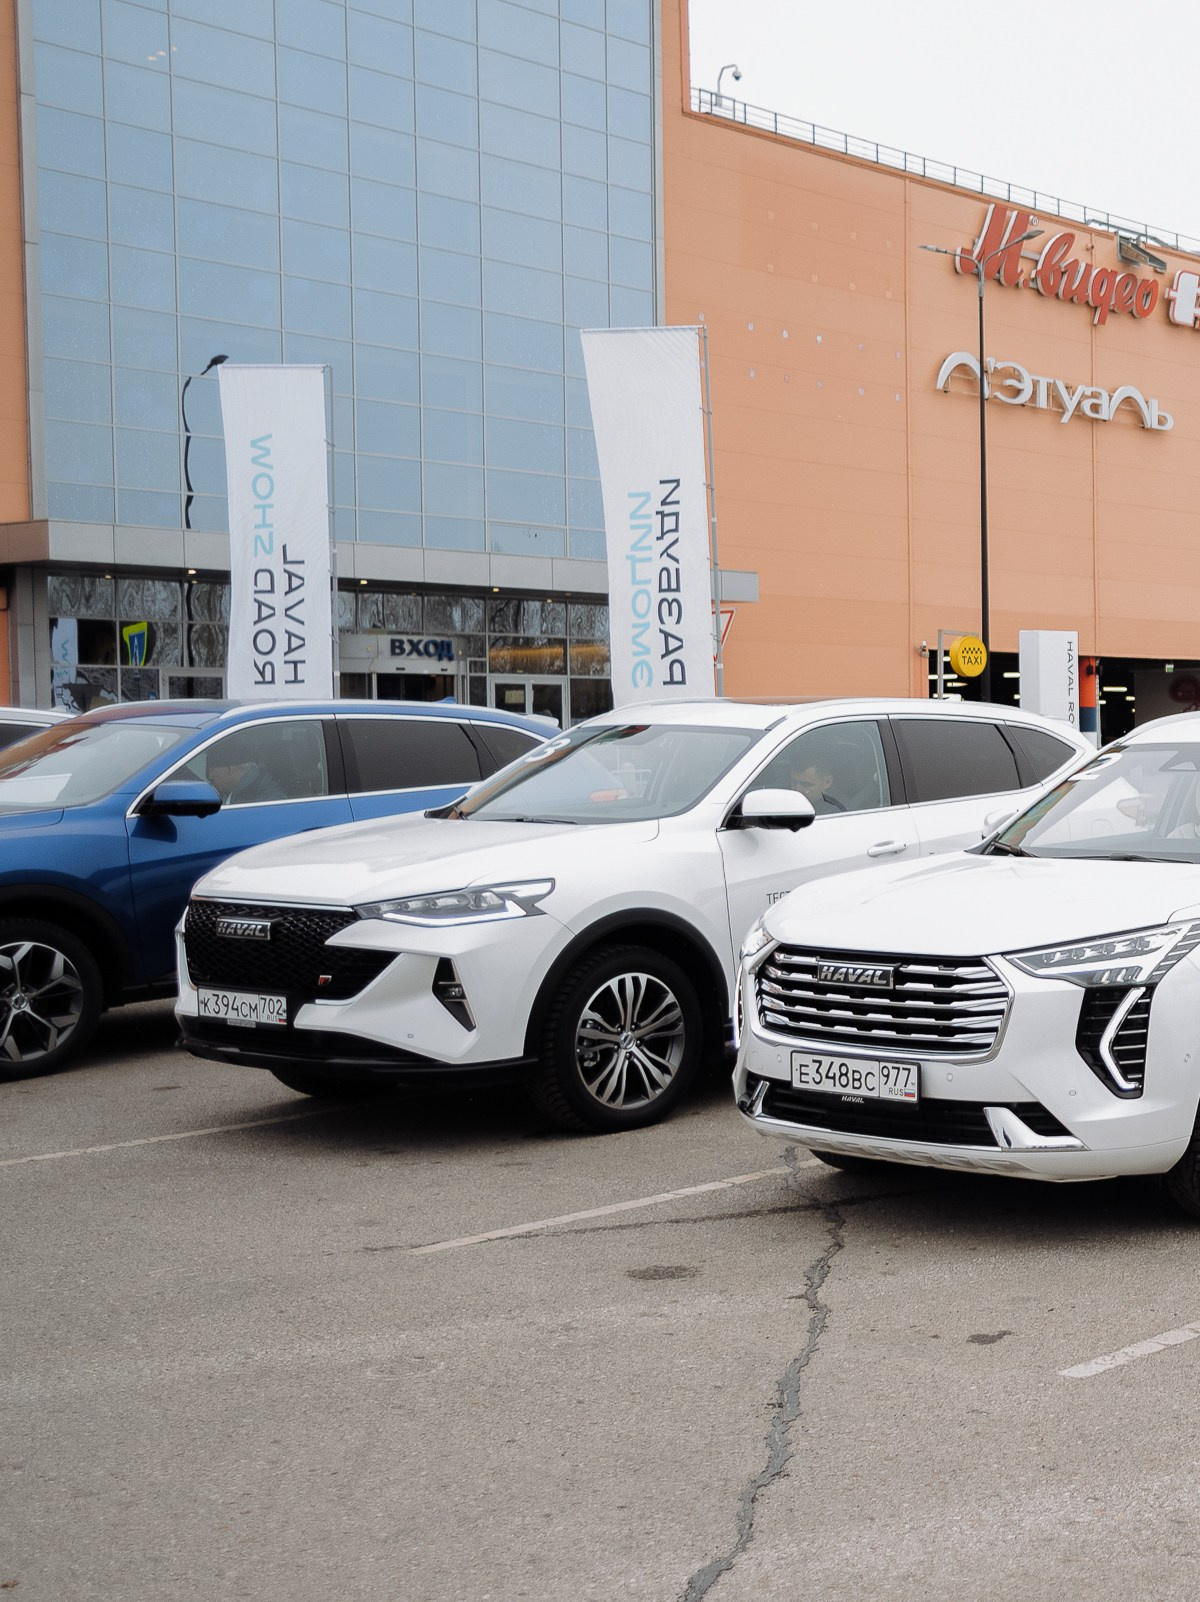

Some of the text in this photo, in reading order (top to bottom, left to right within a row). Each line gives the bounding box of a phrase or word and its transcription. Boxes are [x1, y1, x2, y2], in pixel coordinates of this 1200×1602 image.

[390, 638, 454, 662] ВХОД
[961, 655, 983, 667] TAXI
[218, 922, 265, 937] HAVAL
[820, 966, 887, 985] HAVAL
[888, 1087, 904, 1097] RUS
[841, 1095, 865, 1104] HAVAL
